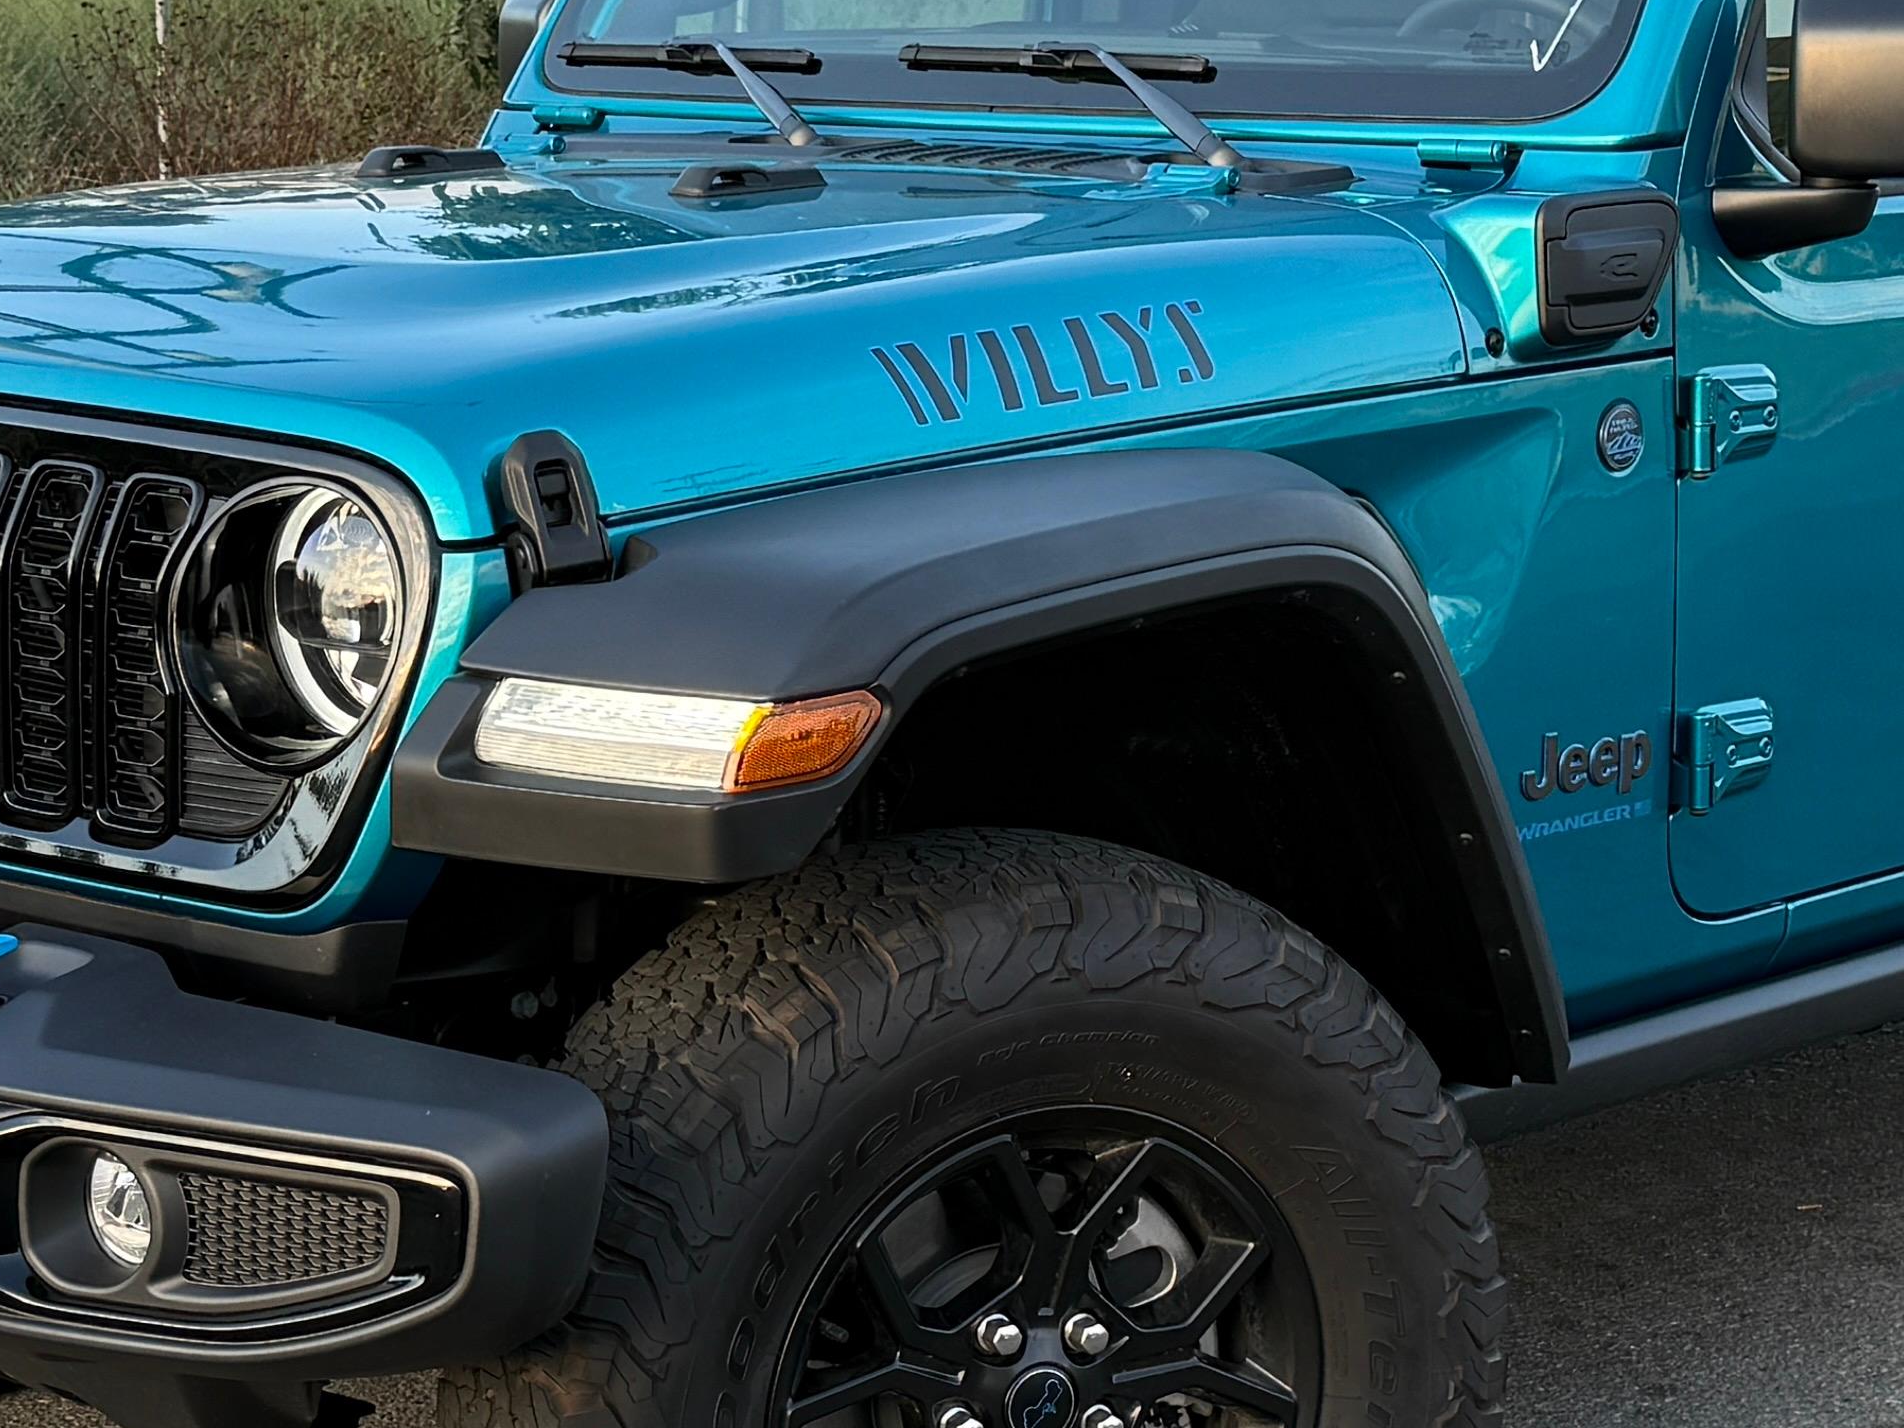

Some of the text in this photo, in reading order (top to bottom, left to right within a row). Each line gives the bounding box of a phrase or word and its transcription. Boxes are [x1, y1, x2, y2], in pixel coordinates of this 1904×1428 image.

[870, 299, 1215, 426] WILLYS
[1521, 730, 1652, 801] Jeep
[1516, 804, 1631, 843] WRANGLER
